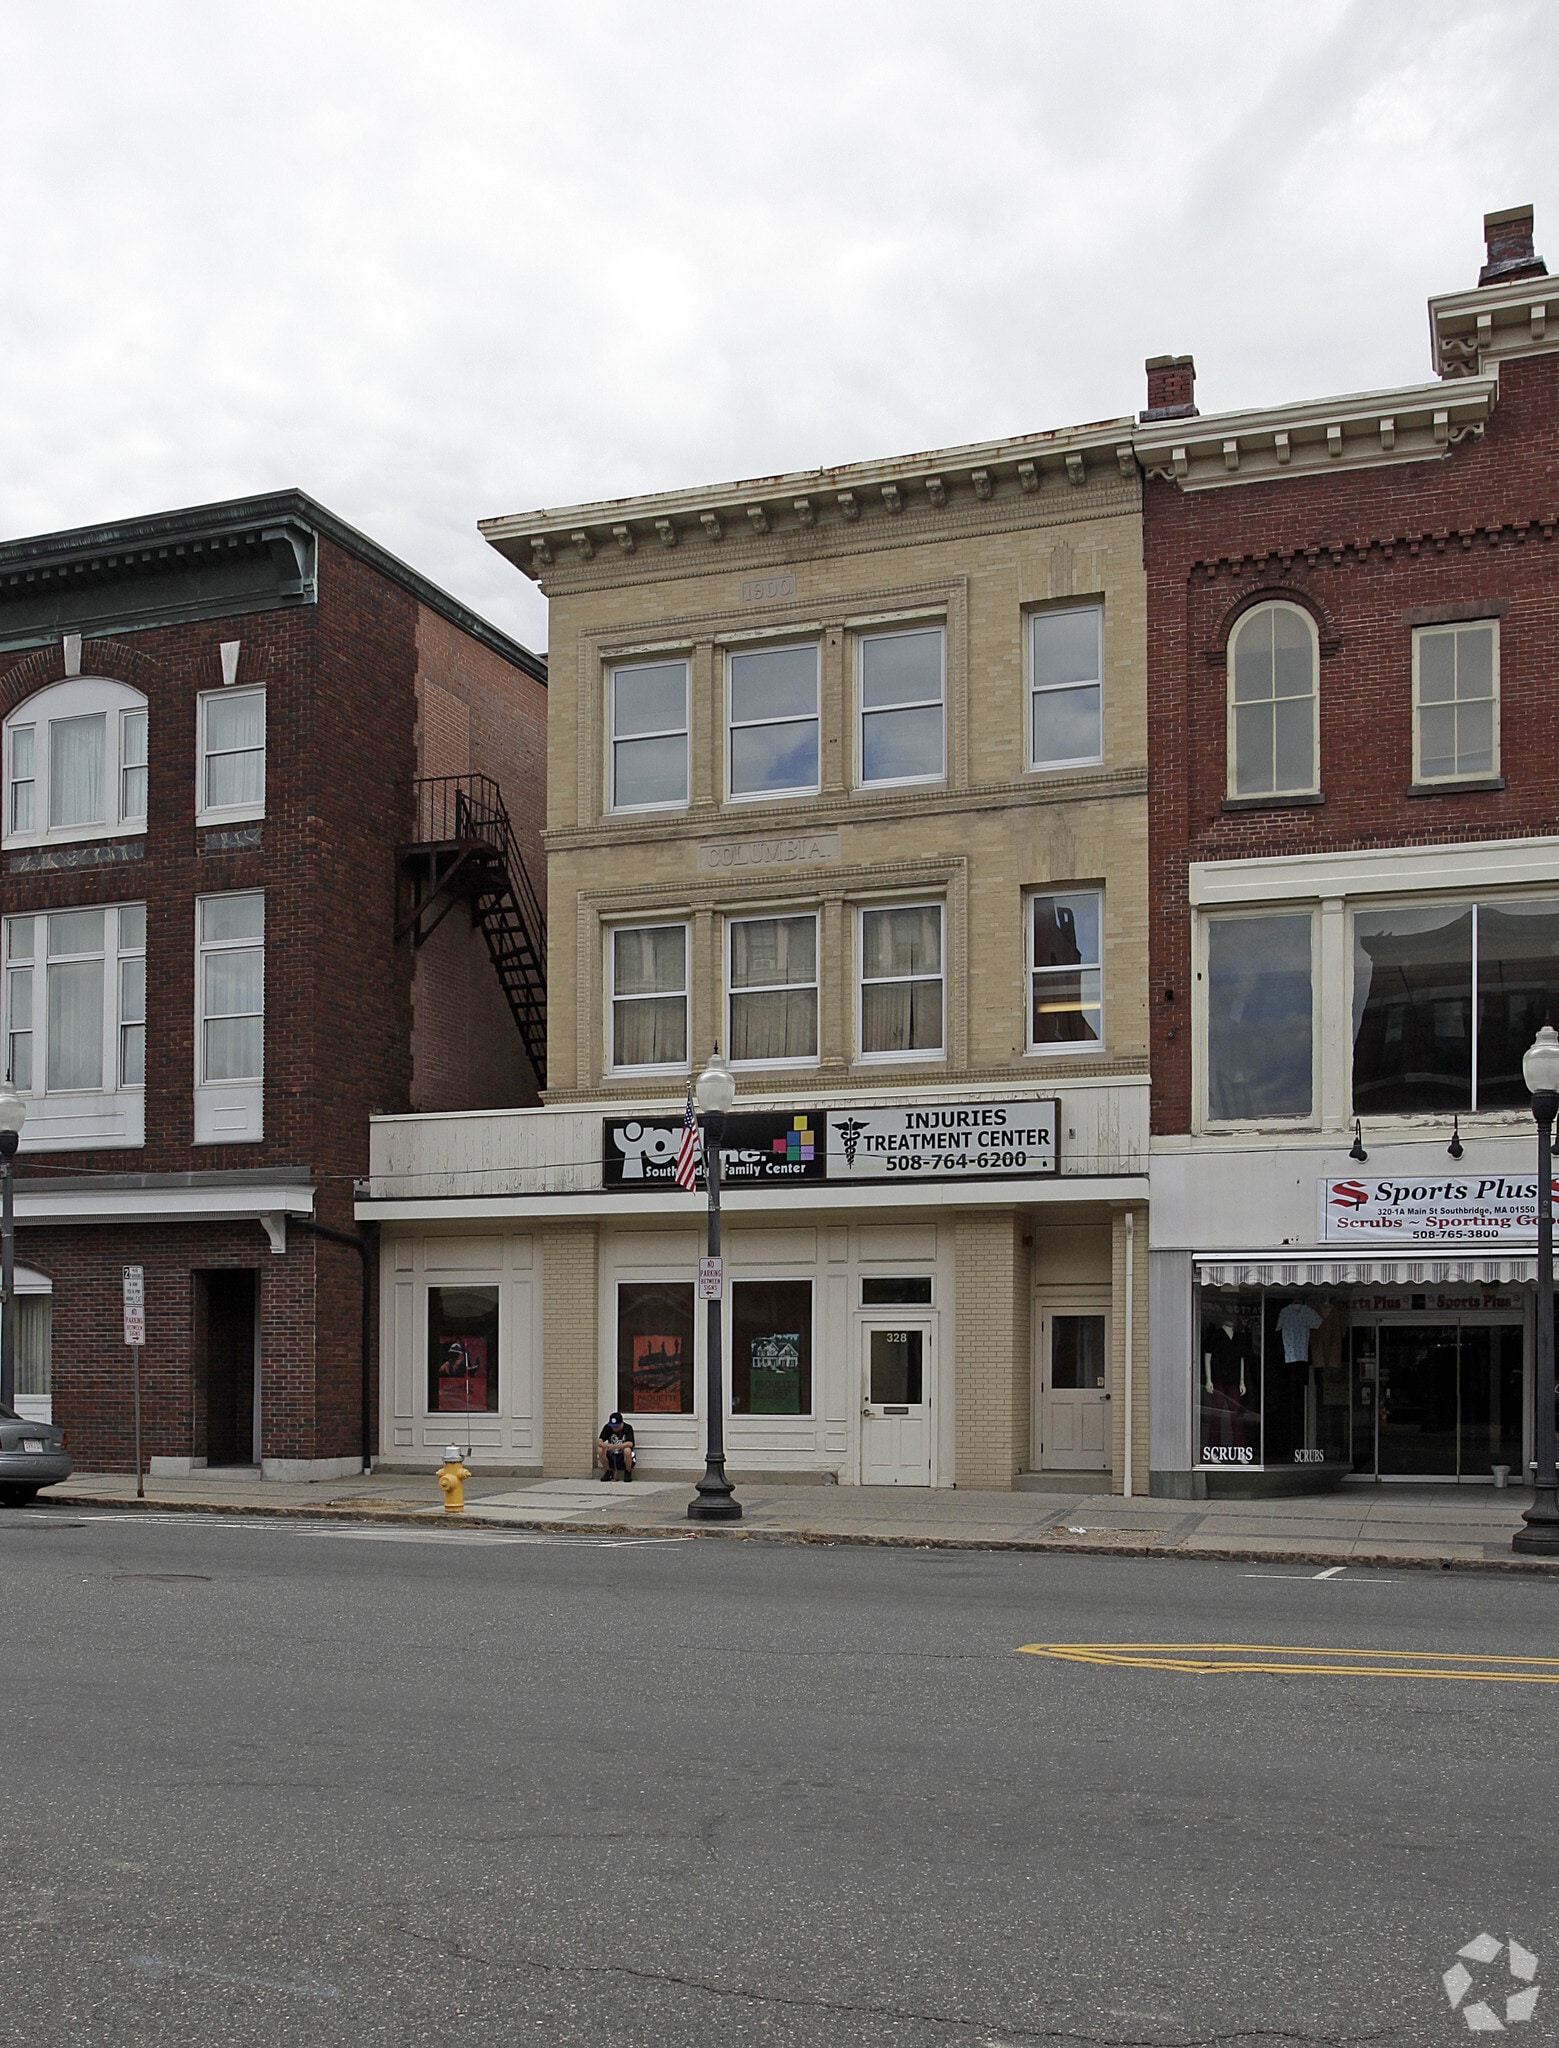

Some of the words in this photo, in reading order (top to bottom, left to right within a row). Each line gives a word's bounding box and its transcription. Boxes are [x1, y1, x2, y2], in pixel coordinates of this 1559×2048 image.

[905, 1109, 1007, 1130] INJURIES
[863, 1132, 972, 1151] TREATMENT
[977, 1128, 1050, 1147] CENTER
[765, 1163, 806, 1174] Center
[886, 1151, 1027, 1171] 508-764-6200
[1374, 1182, 1468, 1206] Sports
[1474, 1179, 1538, 1199] Plus
[1440, 1207, 1492, 1216] Southbridge,
[1494, 1206, 1507, 1214] MA
[1509, 1206, 1535, 1214] 01550
[1337, 1216, 1403, 1228] Scrubs
[1425, 1215, 1511, 1229] Sporting
[1412, 1230, 1499, 1239] 508-765-3800
[1437, 1295, 1481, 1310] Sports
[886, 1332, 907, 1343] 328
[1202, 1446, 1253, 1461] SCRUBS
[1294, 1448, 1324, 1463] SCRUBS
